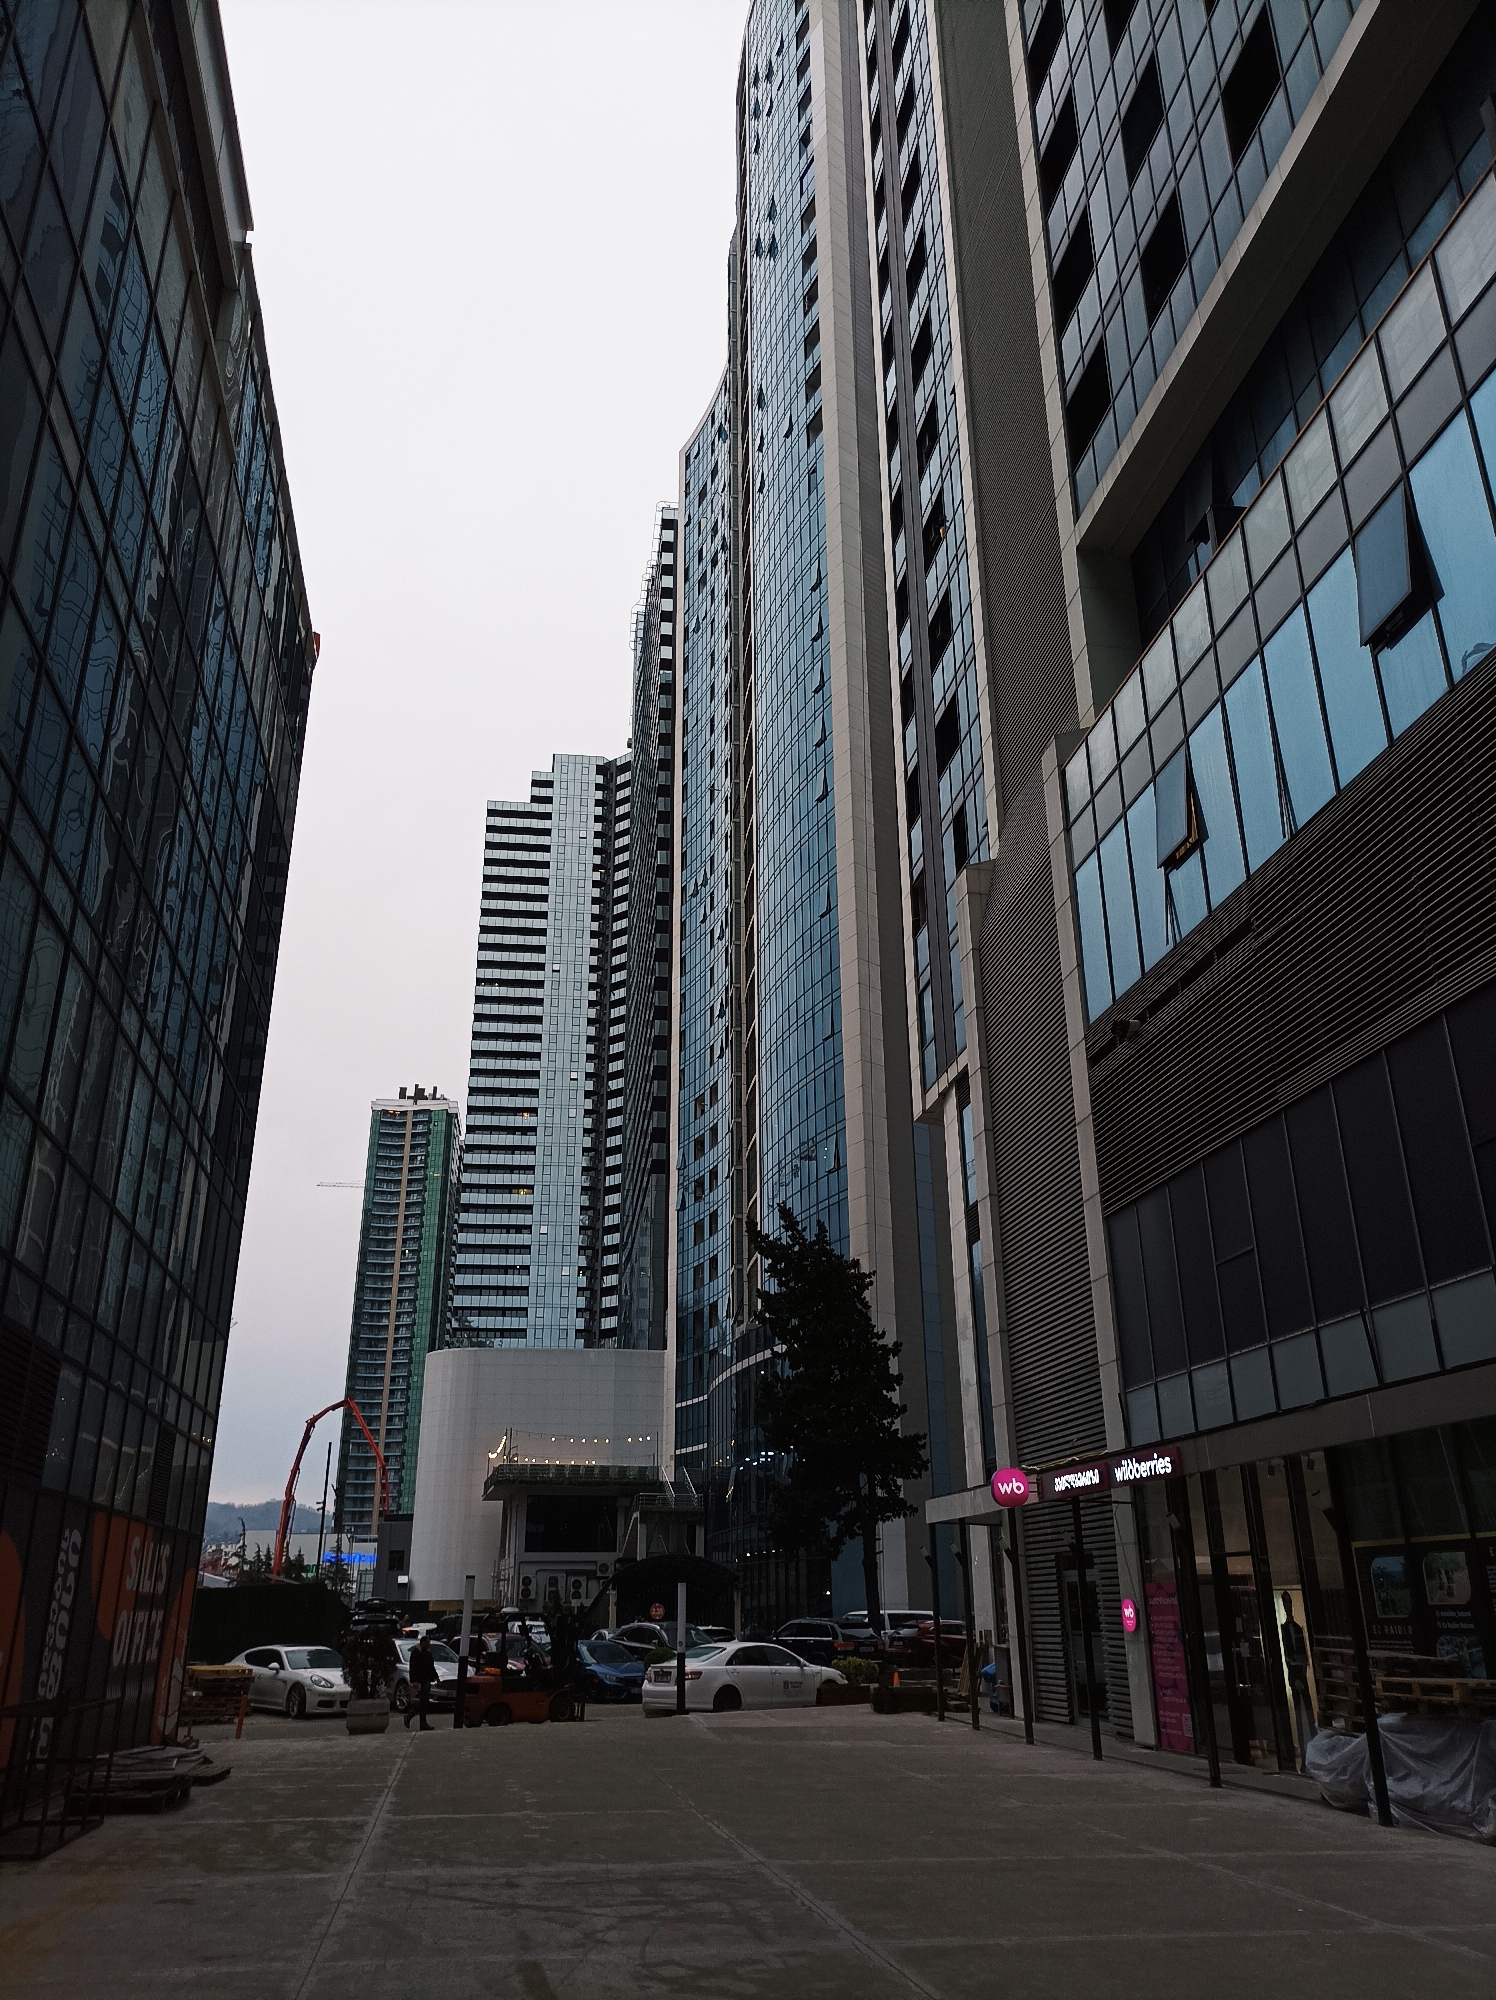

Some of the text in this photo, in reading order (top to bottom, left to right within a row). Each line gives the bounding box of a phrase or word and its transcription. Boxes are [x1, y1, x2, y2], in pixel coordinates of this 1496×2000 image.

[1114, 1452, 1172, 1482] wildberries
[997, 1478, 1025, 1495] wb
[1124, 1604, 1134, 1618] wb
[1384, 1624, 1412, 1635] RAIDER
